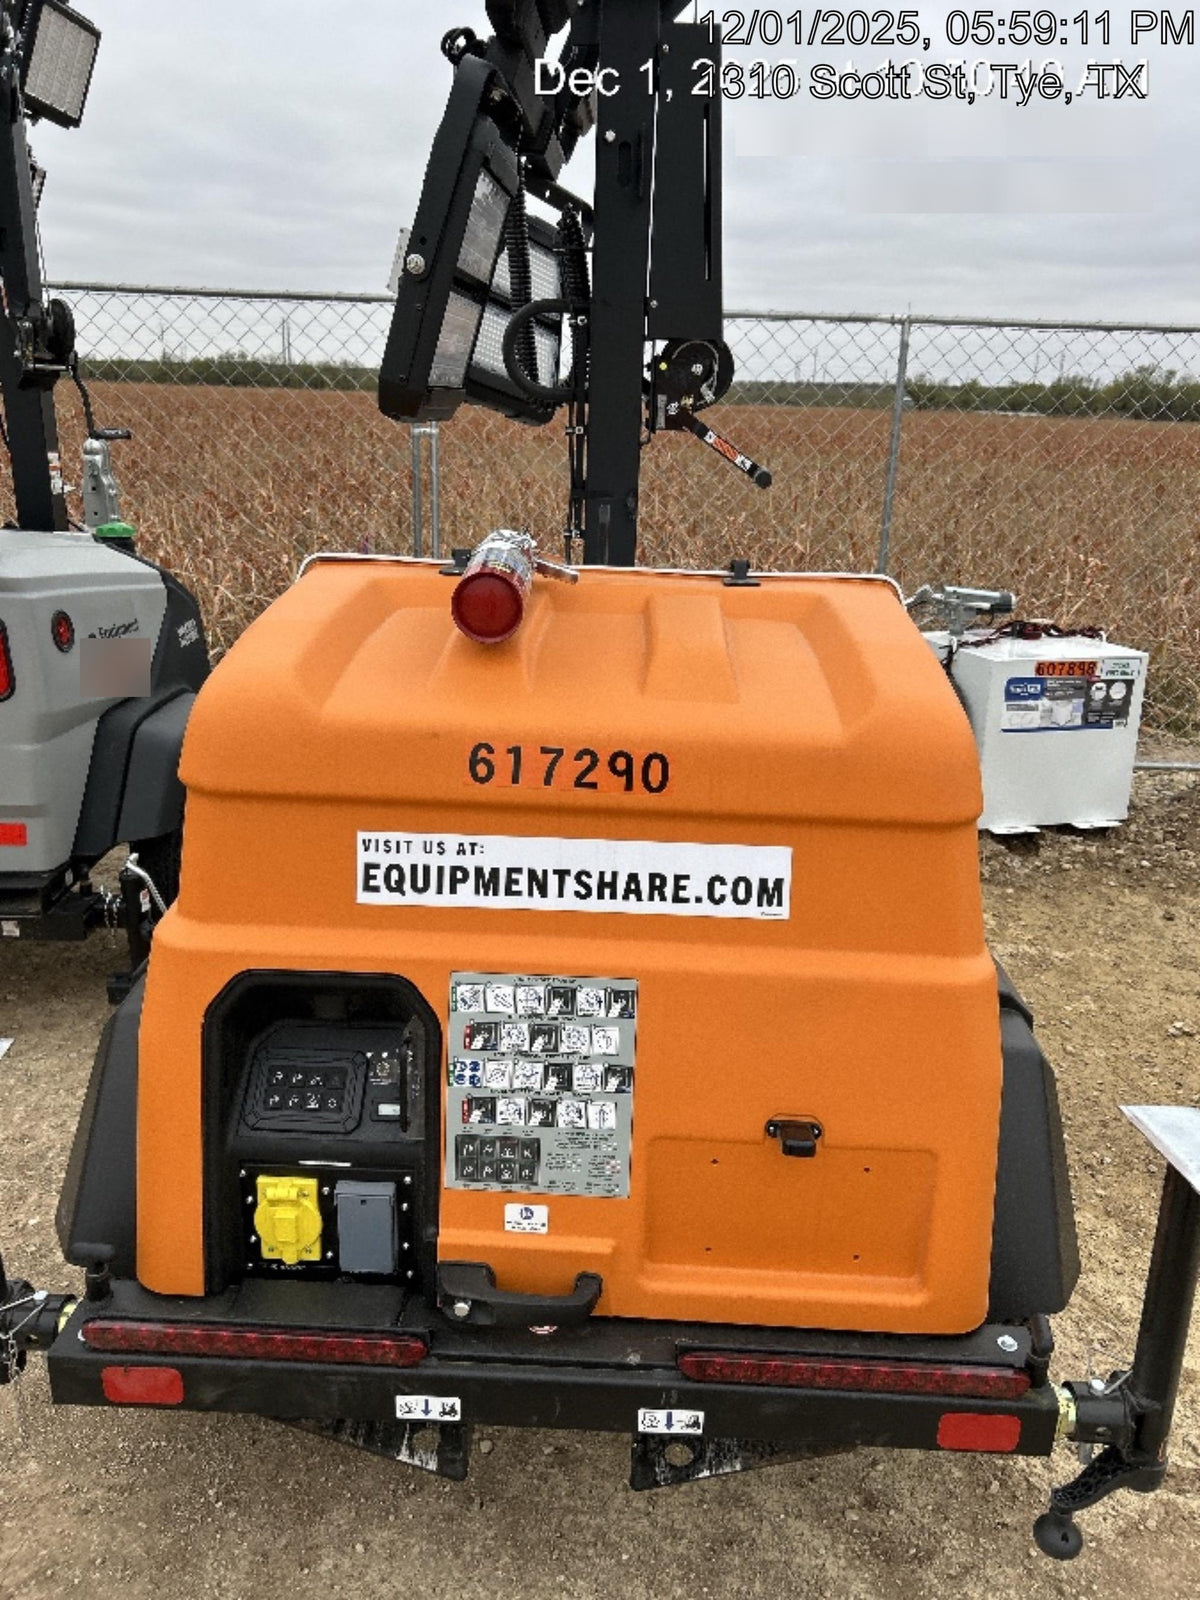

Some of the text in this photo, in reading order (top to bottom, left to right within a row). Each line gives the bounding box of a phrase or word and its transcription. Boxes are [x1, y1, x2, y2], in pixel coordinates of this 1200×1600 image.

[468, 742, 670, 794] 617290
[362, 839, 485, 856] VISIT US AT:
[362, 862, 785, 908] EQUIPMENTSHARE.COM
